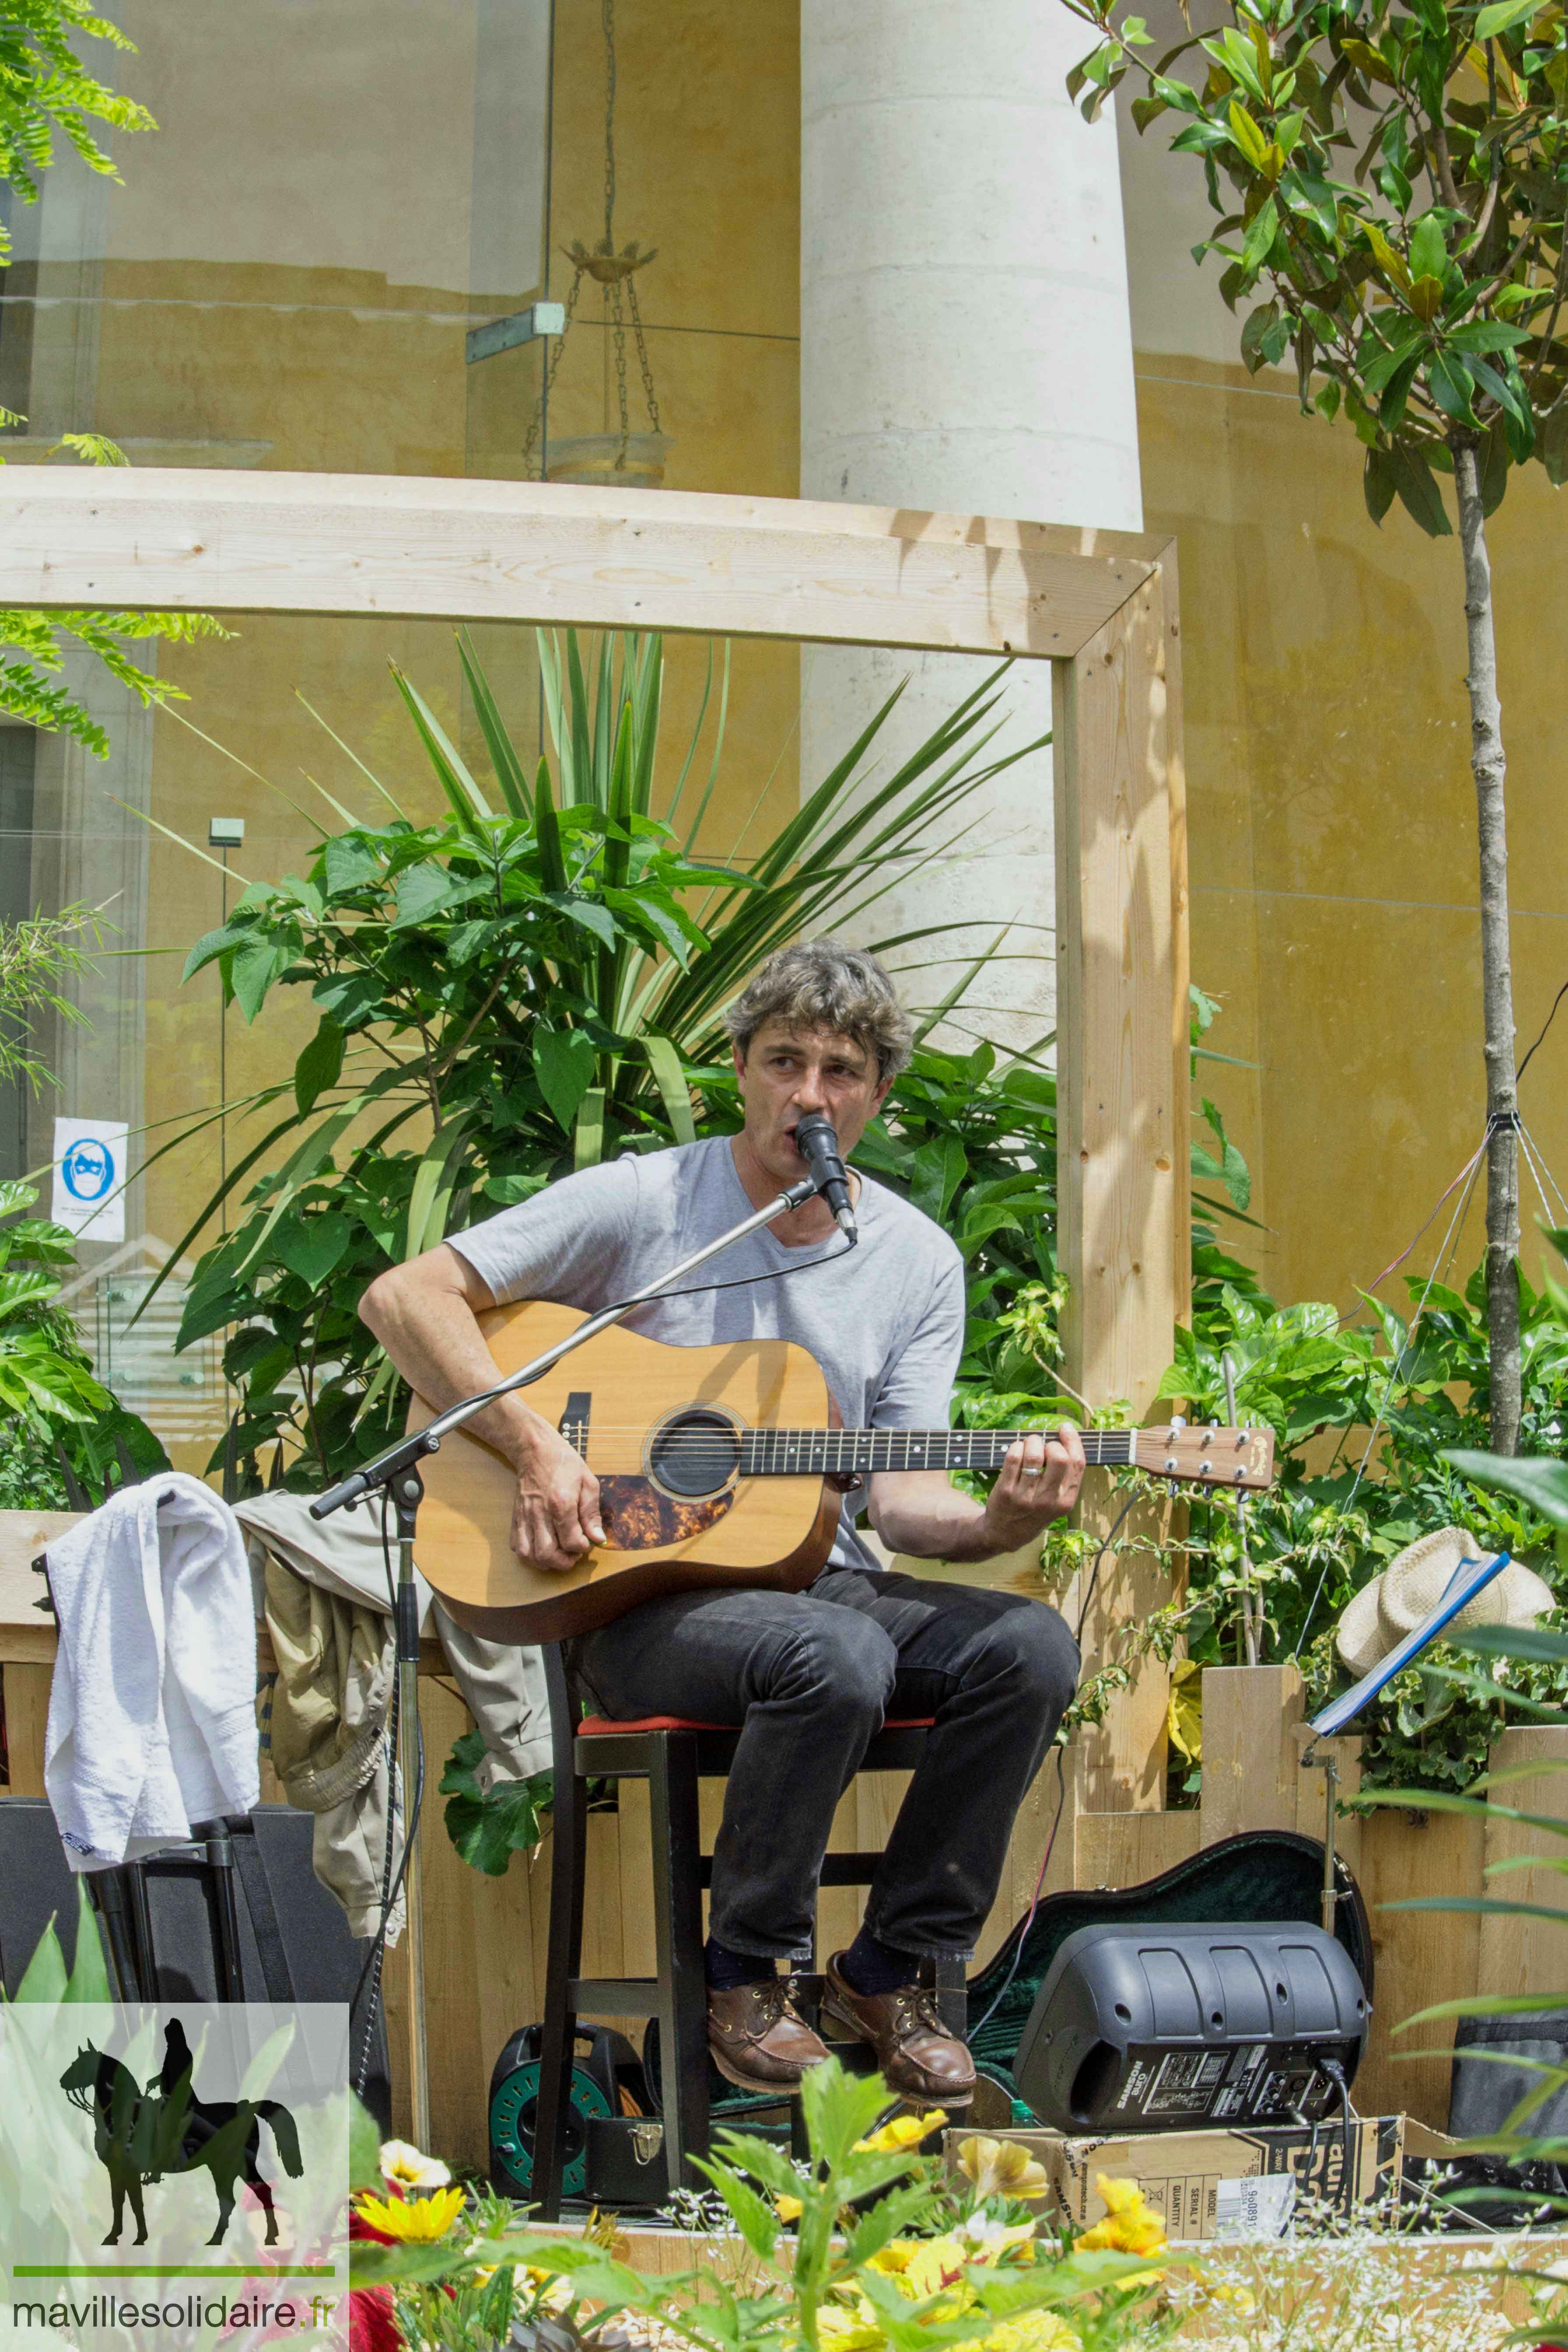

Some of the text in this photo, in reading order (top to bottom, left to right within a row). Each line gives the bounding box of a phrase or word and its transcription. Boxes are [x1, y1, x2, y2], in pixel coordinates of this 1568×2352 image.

[1117, 2060, 1143, 2109] SAMSON
[1274, 2148, 1283, 2172] 2-WAY
[1171, 2185, 1181, 2227] QUANTITY
[1190, 2187, 1199, 2217] SERIAL
[1207, 2189, 1217, 2218] MODEL
